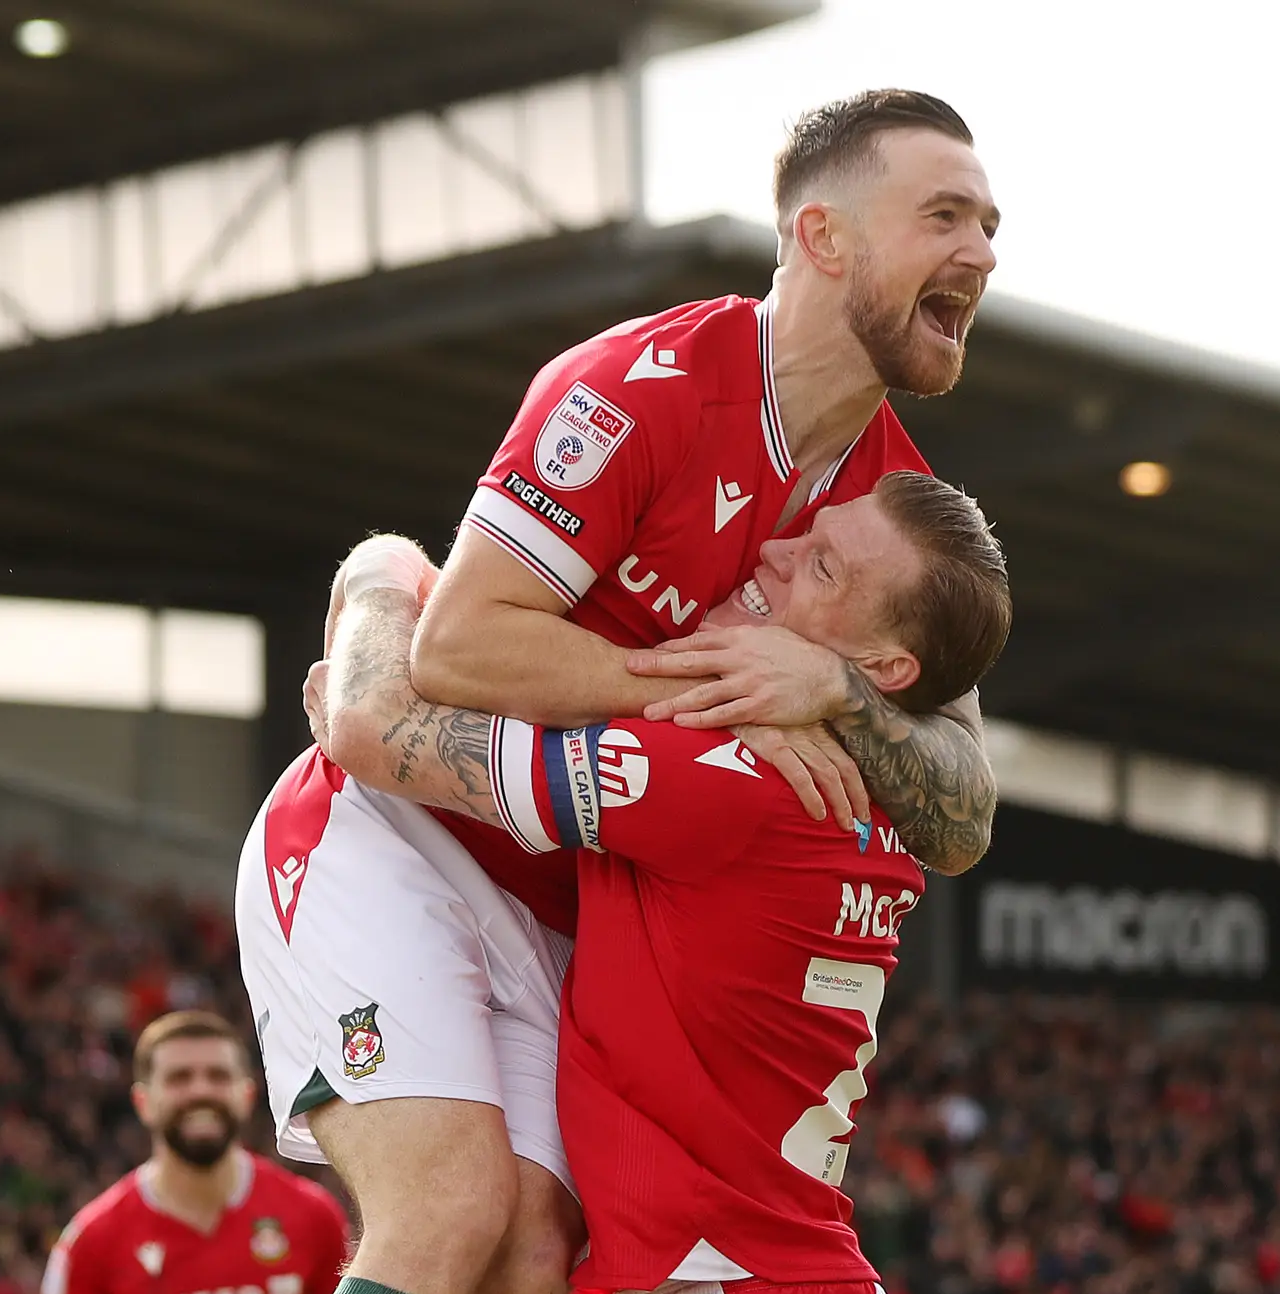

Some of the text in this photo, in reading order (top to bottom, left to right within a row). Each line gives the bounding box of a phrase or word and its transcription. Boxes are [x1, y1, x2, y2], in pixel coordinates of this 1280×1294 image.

[559, 407, 612, 449] LEAGUE TWO
[569, 393, 620, 433] sky bet
[546, 459, 567, 481] EFL
[505, 472, 582, 535] TOGETHER
[569, 739, 584, 767] EFL
[982, 885, 1268, 978] macron
